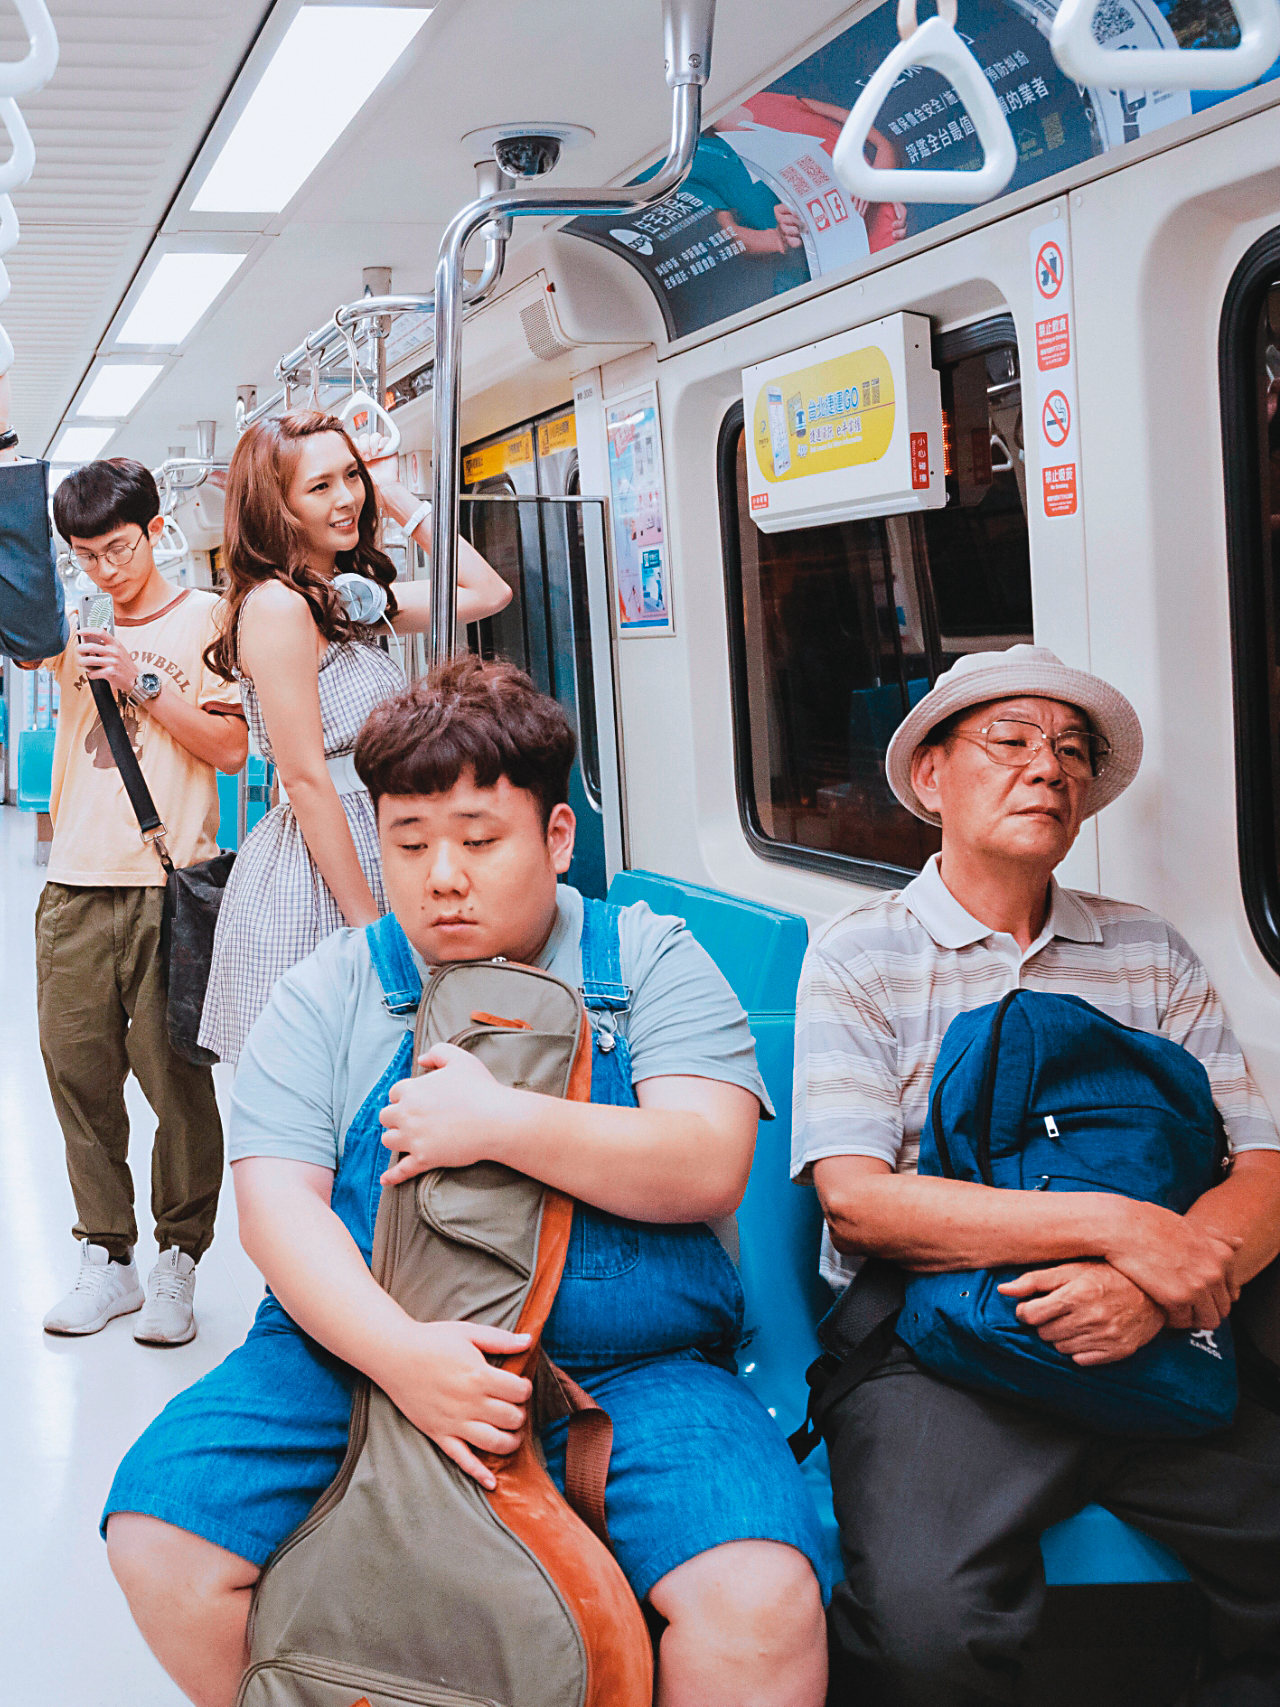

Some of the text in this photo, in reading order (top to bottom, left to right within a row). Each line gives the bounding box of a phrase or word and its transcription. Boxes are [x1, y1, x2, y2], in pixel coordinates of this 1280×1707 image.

[1039, 317, 1067, 337] 禁止飲食
[808, 387, 859, 422] 台北捷運GO
[1045, 467, 1073, 484] 禁止吸菸
[129, 651, 190, 693] OWBELL
